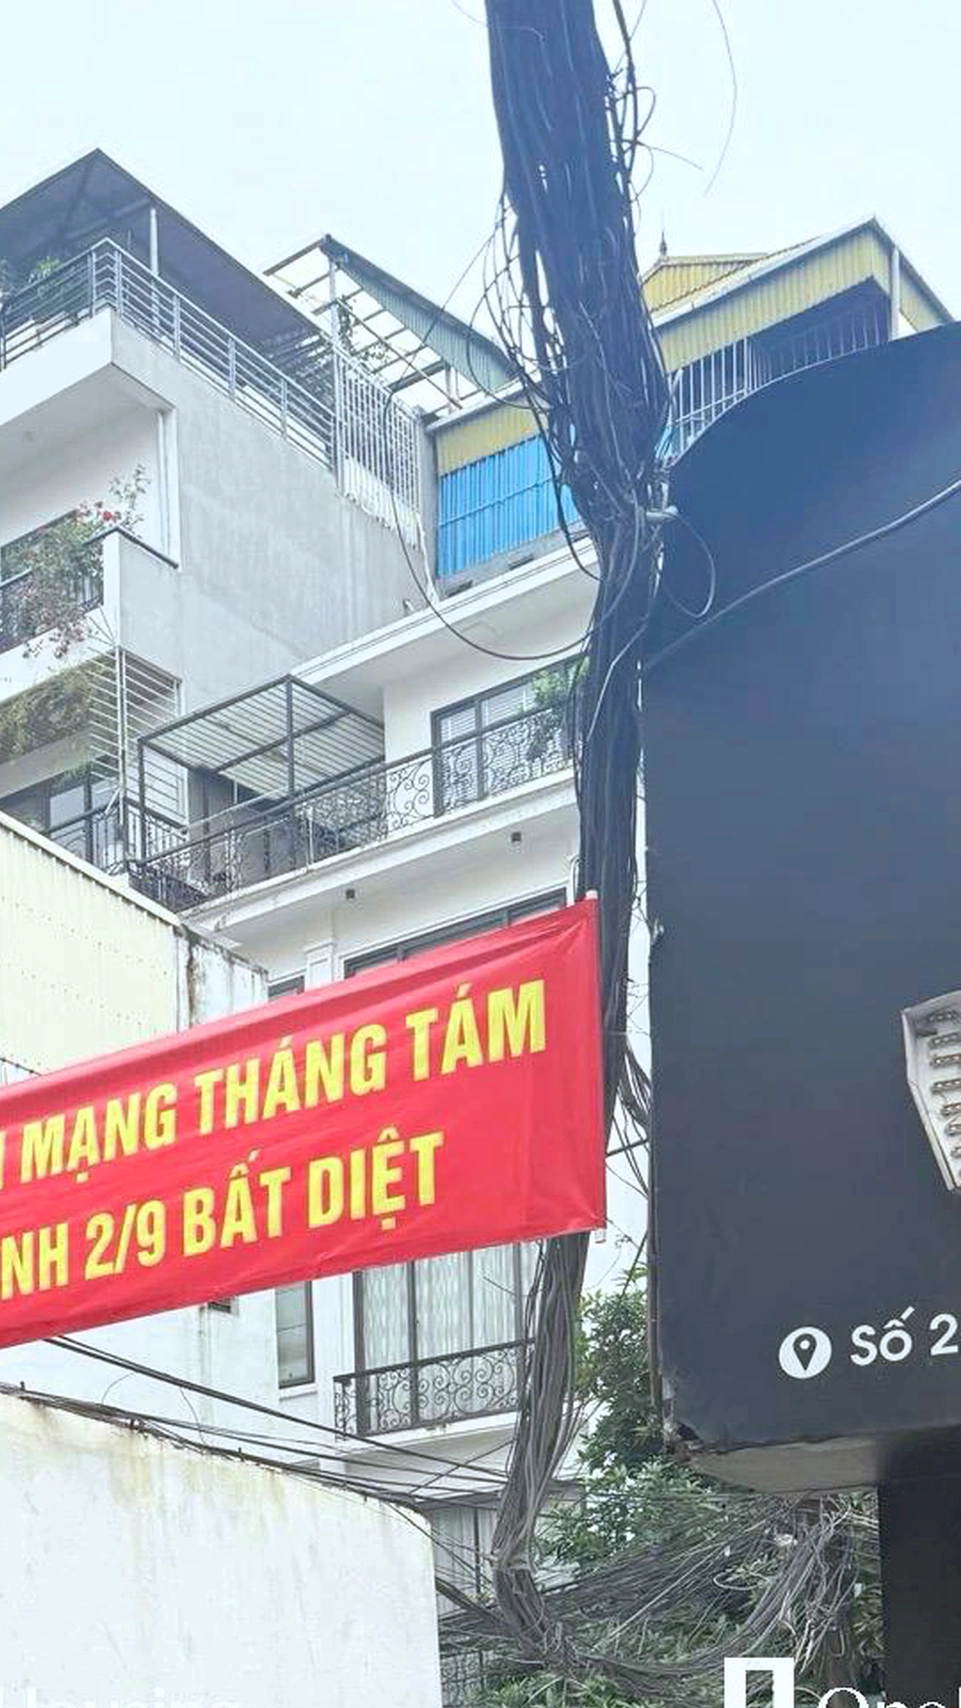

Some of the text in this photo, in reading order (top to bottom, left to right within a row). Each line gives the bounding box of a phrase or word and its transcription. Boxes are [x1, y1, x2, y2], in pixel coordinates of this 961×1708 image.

[20, 1082, 178, 1184] MẠNG
[194, 1023, 388, 1136] THÁNG
[406, 979, 546, 1082] TÁM
[84, 1199, 167, 1281] 2/9
[182, 1149, 292, 1257] BẤT
[308, 1127, 444, 1231] DIỆT
[850, 1306, 915, 1366] Số
